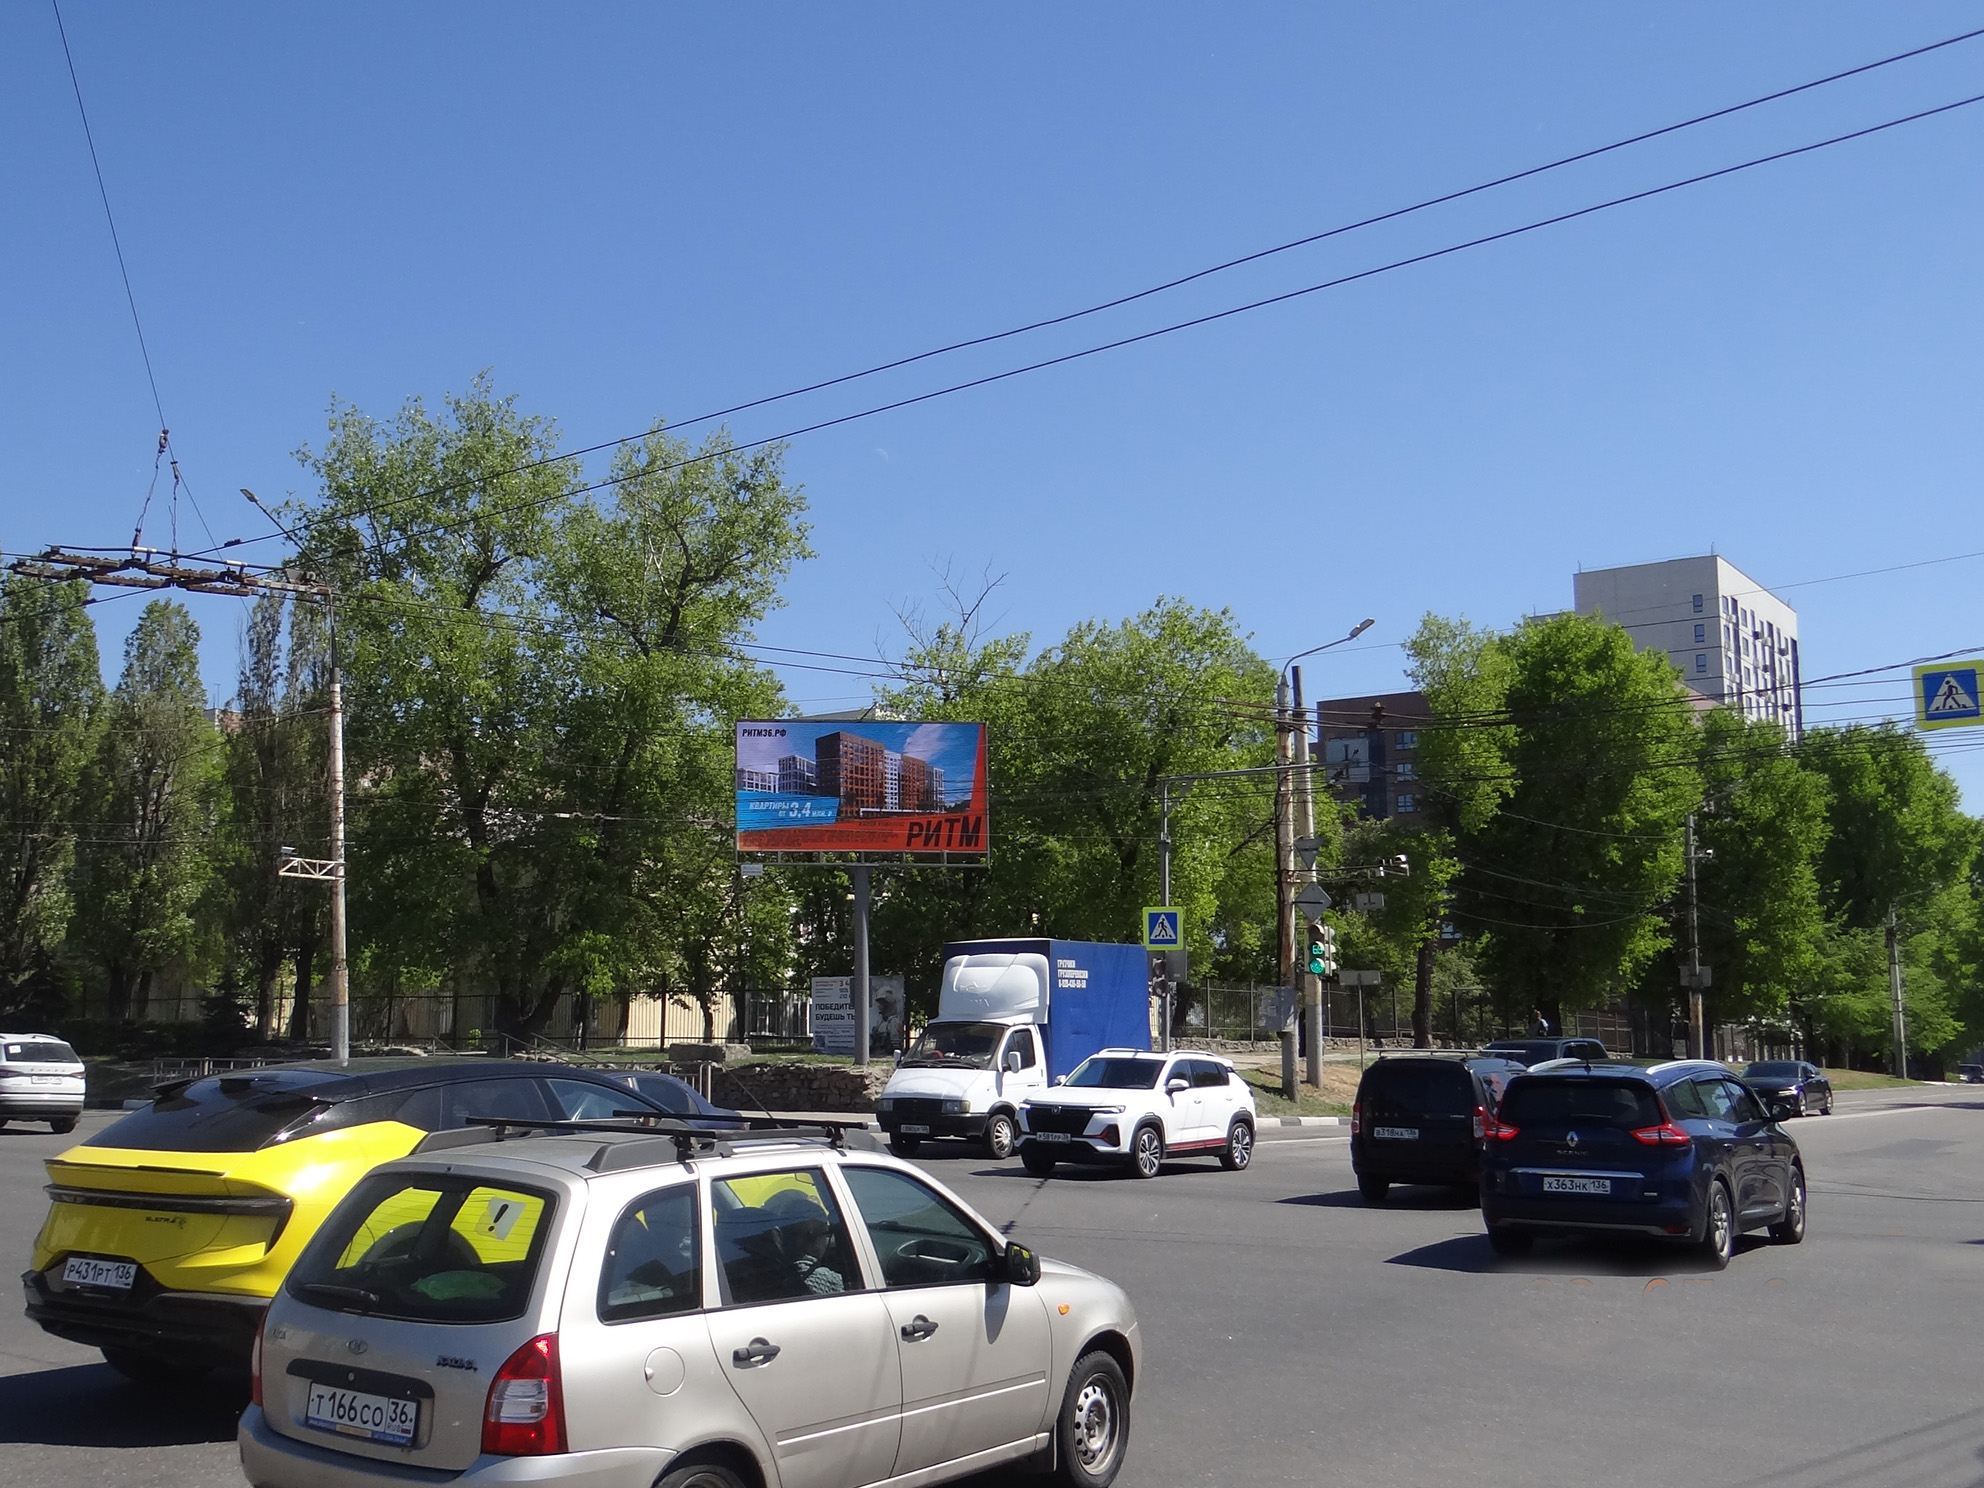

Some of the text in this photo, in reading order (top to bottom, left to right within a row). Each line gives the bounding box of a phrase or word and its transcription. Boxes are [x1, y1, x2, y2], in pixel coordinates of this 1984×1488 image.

[742, 728, 787, 738] РИТМ36.РФ
[749, 801, 790, 810] КВАРТИРЫ
[906, 816, 982, 848] РИТМ
[815, 1013, 845, 1021] БУДЕШЬ
[1546, 1179, 1607, 1191] Х363НК 136
[67, 1261, 132, 1283] Р431РТ 136
[316, 1391, 384, 1427] Т166СО
[388, 1401, 410, 1424] 36
